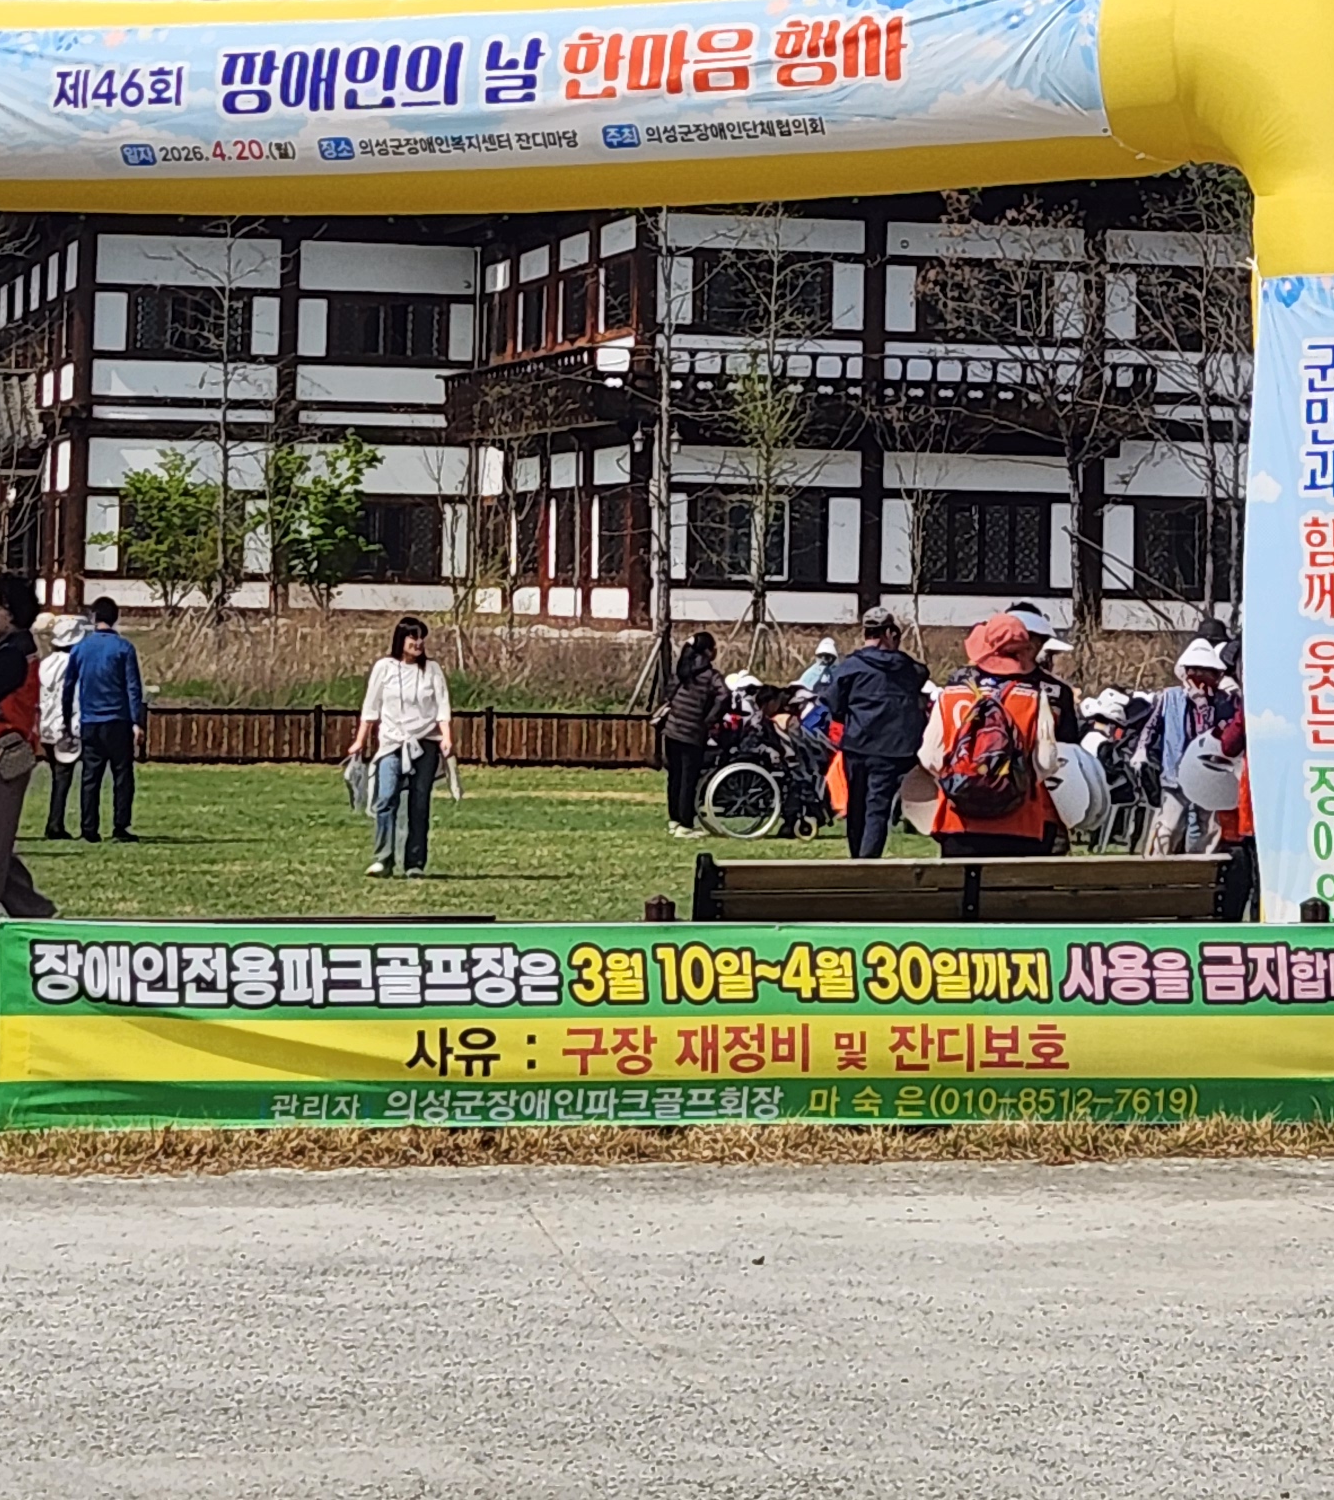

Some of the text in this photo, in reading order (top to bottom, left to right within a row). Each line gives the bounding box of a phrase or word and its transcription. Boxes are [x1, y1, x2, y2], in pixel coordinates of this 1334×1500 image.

[52, 15, 908, 115] 제46회 장애인의 날 한마음 행사
[122, 146, 154, 165] 일자
[320, 140, 353, 160] 장소
[358, 132, 513, 158] 의성군장애인복지센터
[514, 128, 580, 150] 잔디마당
[605, 126, 638, 146] 주최
[646, 115, 827, 144] 의성군장애인단체협의회
[30, 943, 559, 1005] 장애인전용파크골프장은
[569, 947, 647, 1004] 3월
[653, 946, 856, 1002] 10일~4월
[866, 945, 1050, 1001] 30일까지
[1063, 945, 1192, 1001] 사용을
[404, 1023, 1070, 1078] 사유 : 구장 재정비 및 잔디보호
[270, 1093, 361, 1121] 관리자
[383, 1085, 784, 1122] 의성군장애인파크골프회장
[808, 1085, 840, 1117] 마
[851, 1087, 883, 1117] 숙
